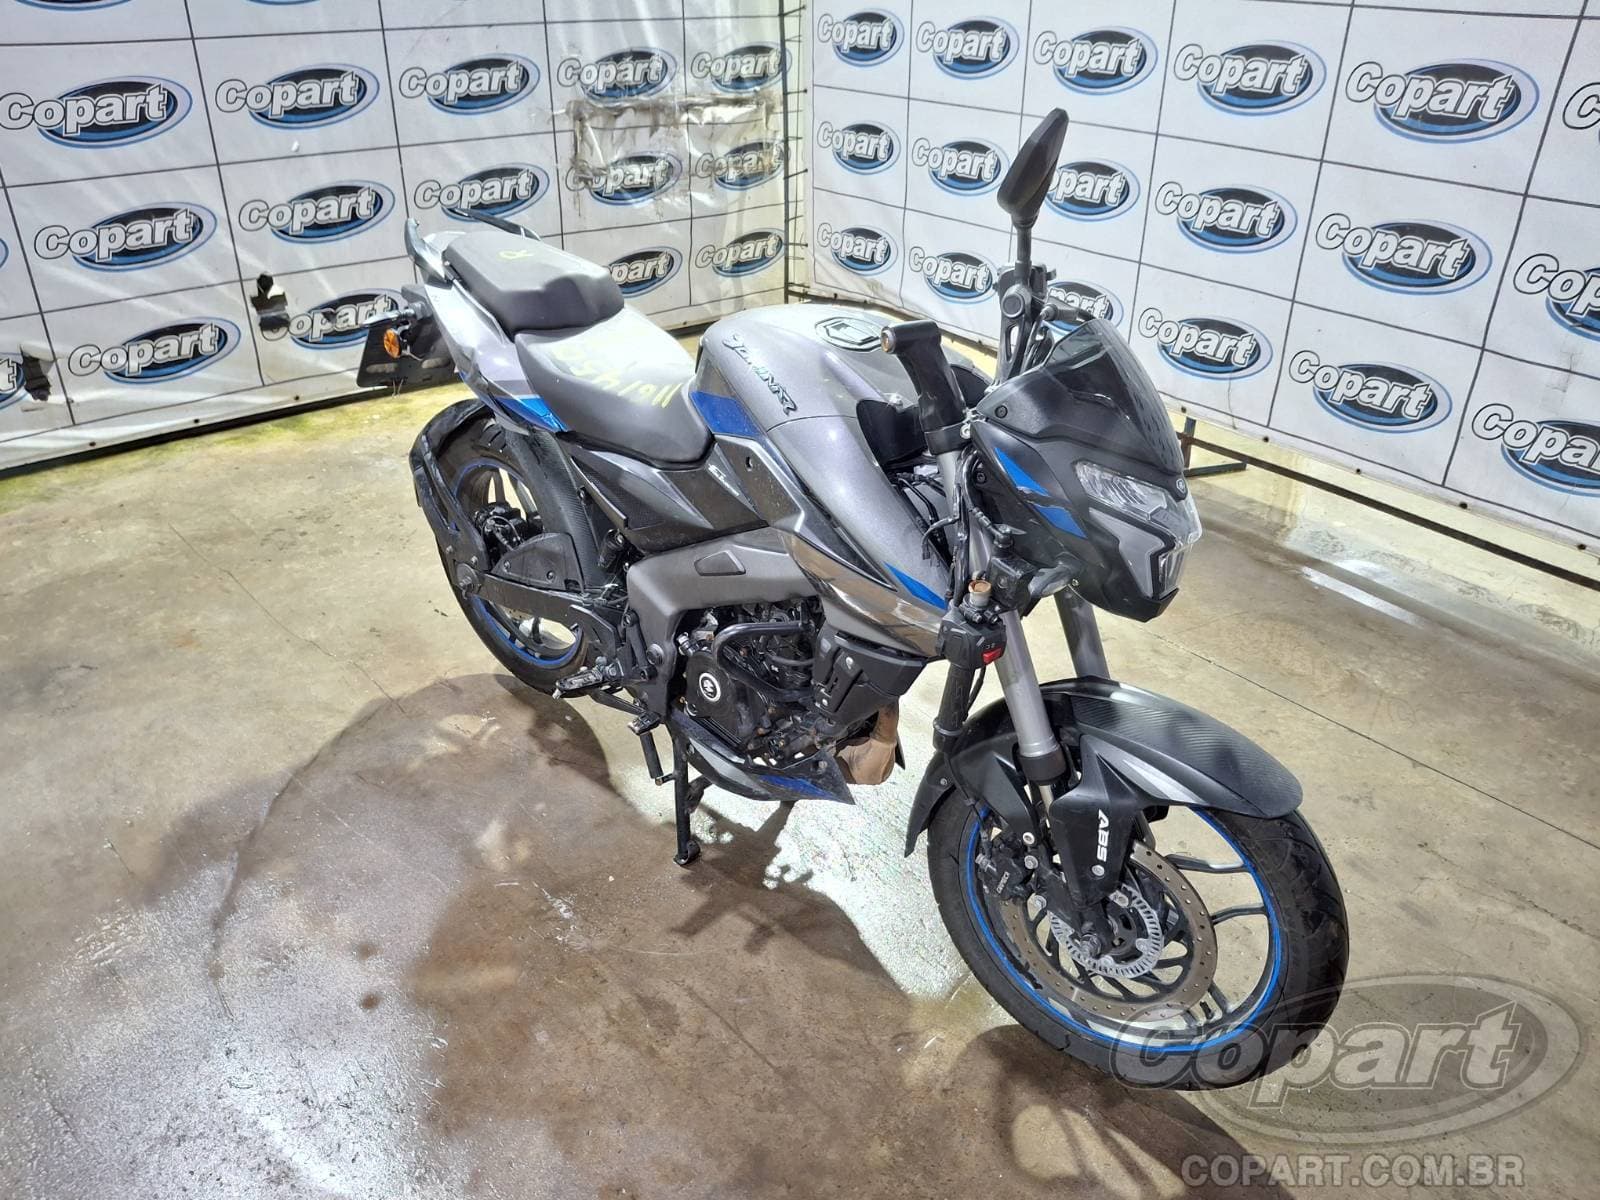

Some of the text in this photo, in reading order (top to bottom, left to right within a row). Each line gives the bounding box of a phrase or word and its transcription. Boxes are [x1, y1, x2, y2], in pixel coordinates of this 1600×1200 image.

[817, 13, 894, 52] Copart
[916, 21, 1007, 64] Copart
[1033, 30, 1142, 78] Copart
[399, 61, 526, 105] Copart
[557, 54, 665, 91] Copart
[691, 46, 781, 81] Copart
[1173, 43, 1309, 96] Copart
[0, 84, 167, 136] Copart
[215, 71, 360, 119] Copart
[1345, 60, 1518, 122] Copart
[817, 121, 890, 163] Copart
[912, 137, 998, 183] Copart
[239, 186, 376, 235] Copart
[414, 170, 534, 210] Copart
[1050, 169, 1126, 207] part
[1155, 181, 1281, 239] Copart
[34, 208, 195, 262] Copart
[695, 233, 780, 271] Copart
[817, 222, 889, 265] Copart
[1315, 212, 1470, 280] Copart
[606, 251, 671, 284] part
[908, 246, 994, 294] Copart
[1512, 253, 1600, 318] Cop
[69, 322, 219, 377] Copart
[1138, 307, 1258, 368] Copart
[1288, 350, 1437, 421] Copart
[1471, 403, 1600, 475] Copa
[1097, 808, 1110, 863] ABS
